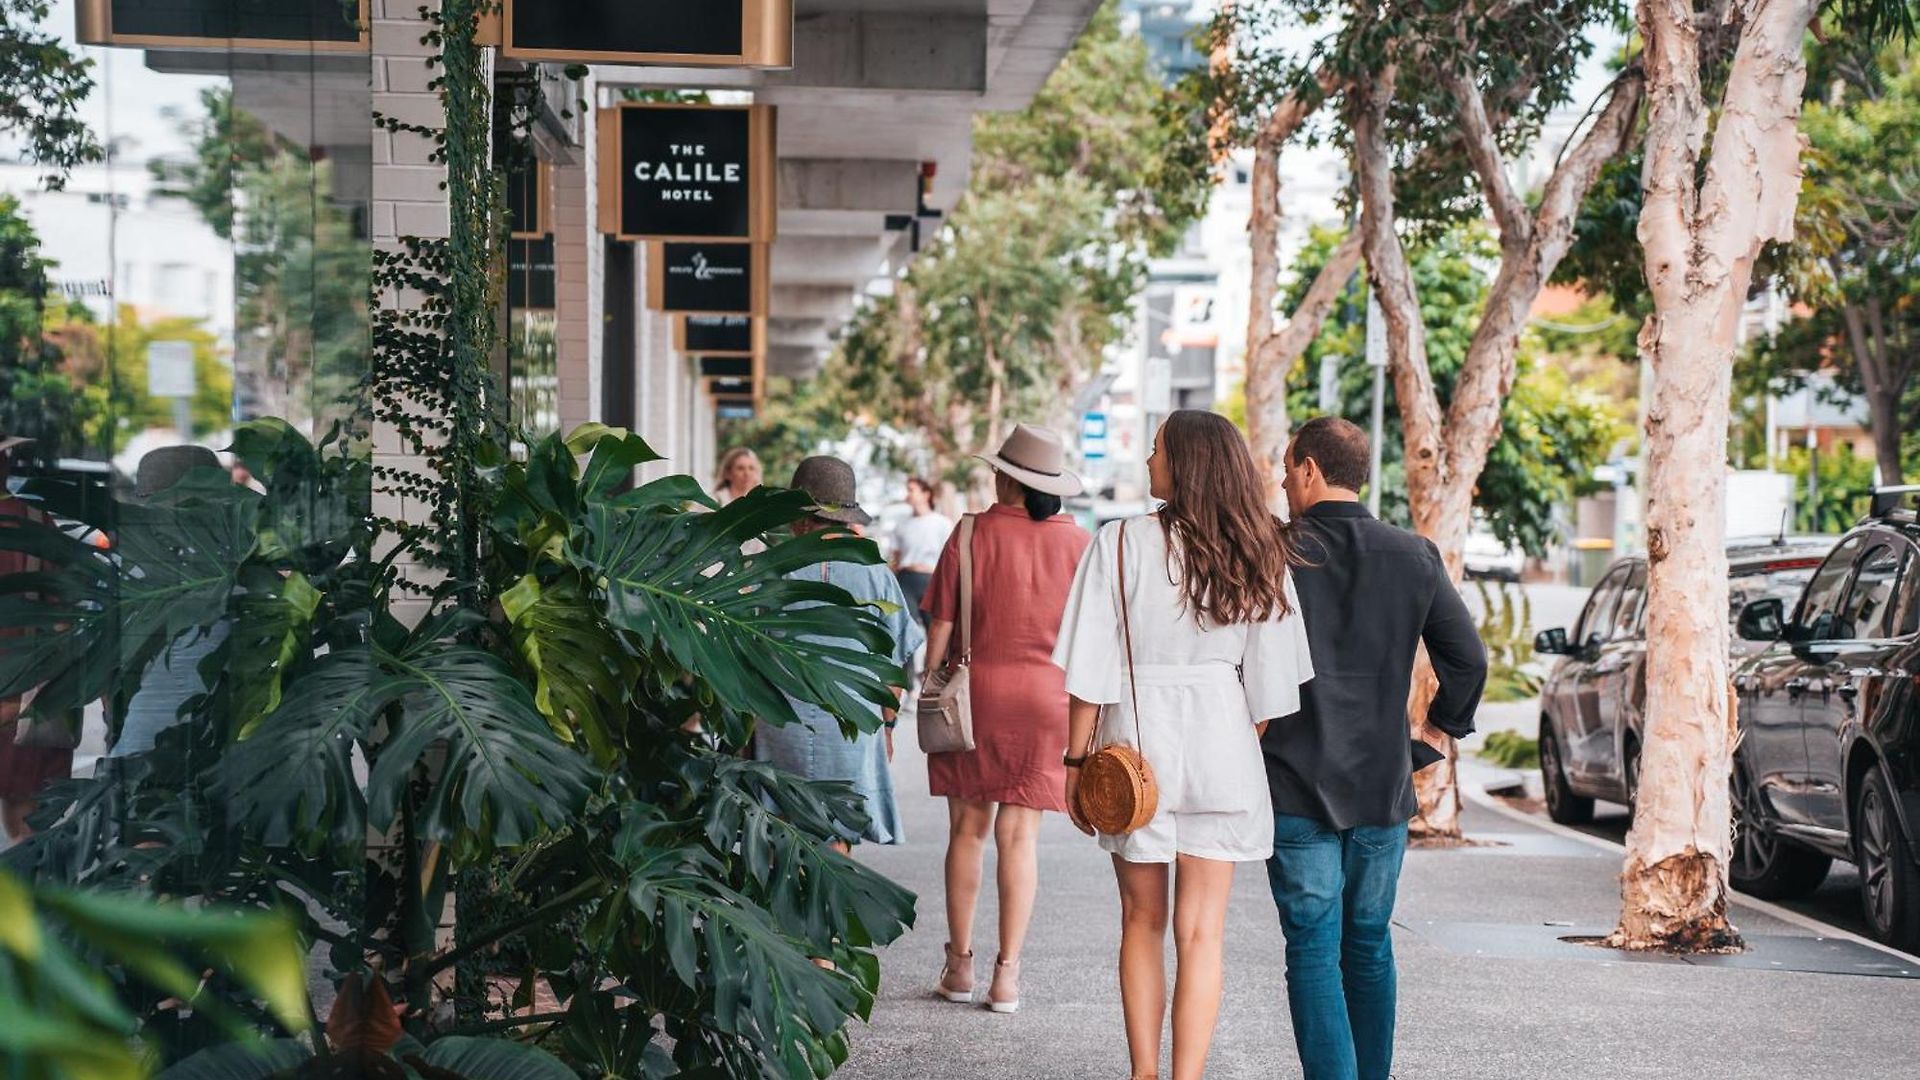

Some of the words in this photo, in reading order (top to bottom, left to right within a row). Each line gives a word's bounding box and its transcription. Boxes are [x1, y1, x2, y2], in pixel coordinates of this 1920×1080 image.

[670, 144, 705, 156] THE
[634, 161, 740, 181] CALILE
[661, 189, 713, 201] HOTEL
